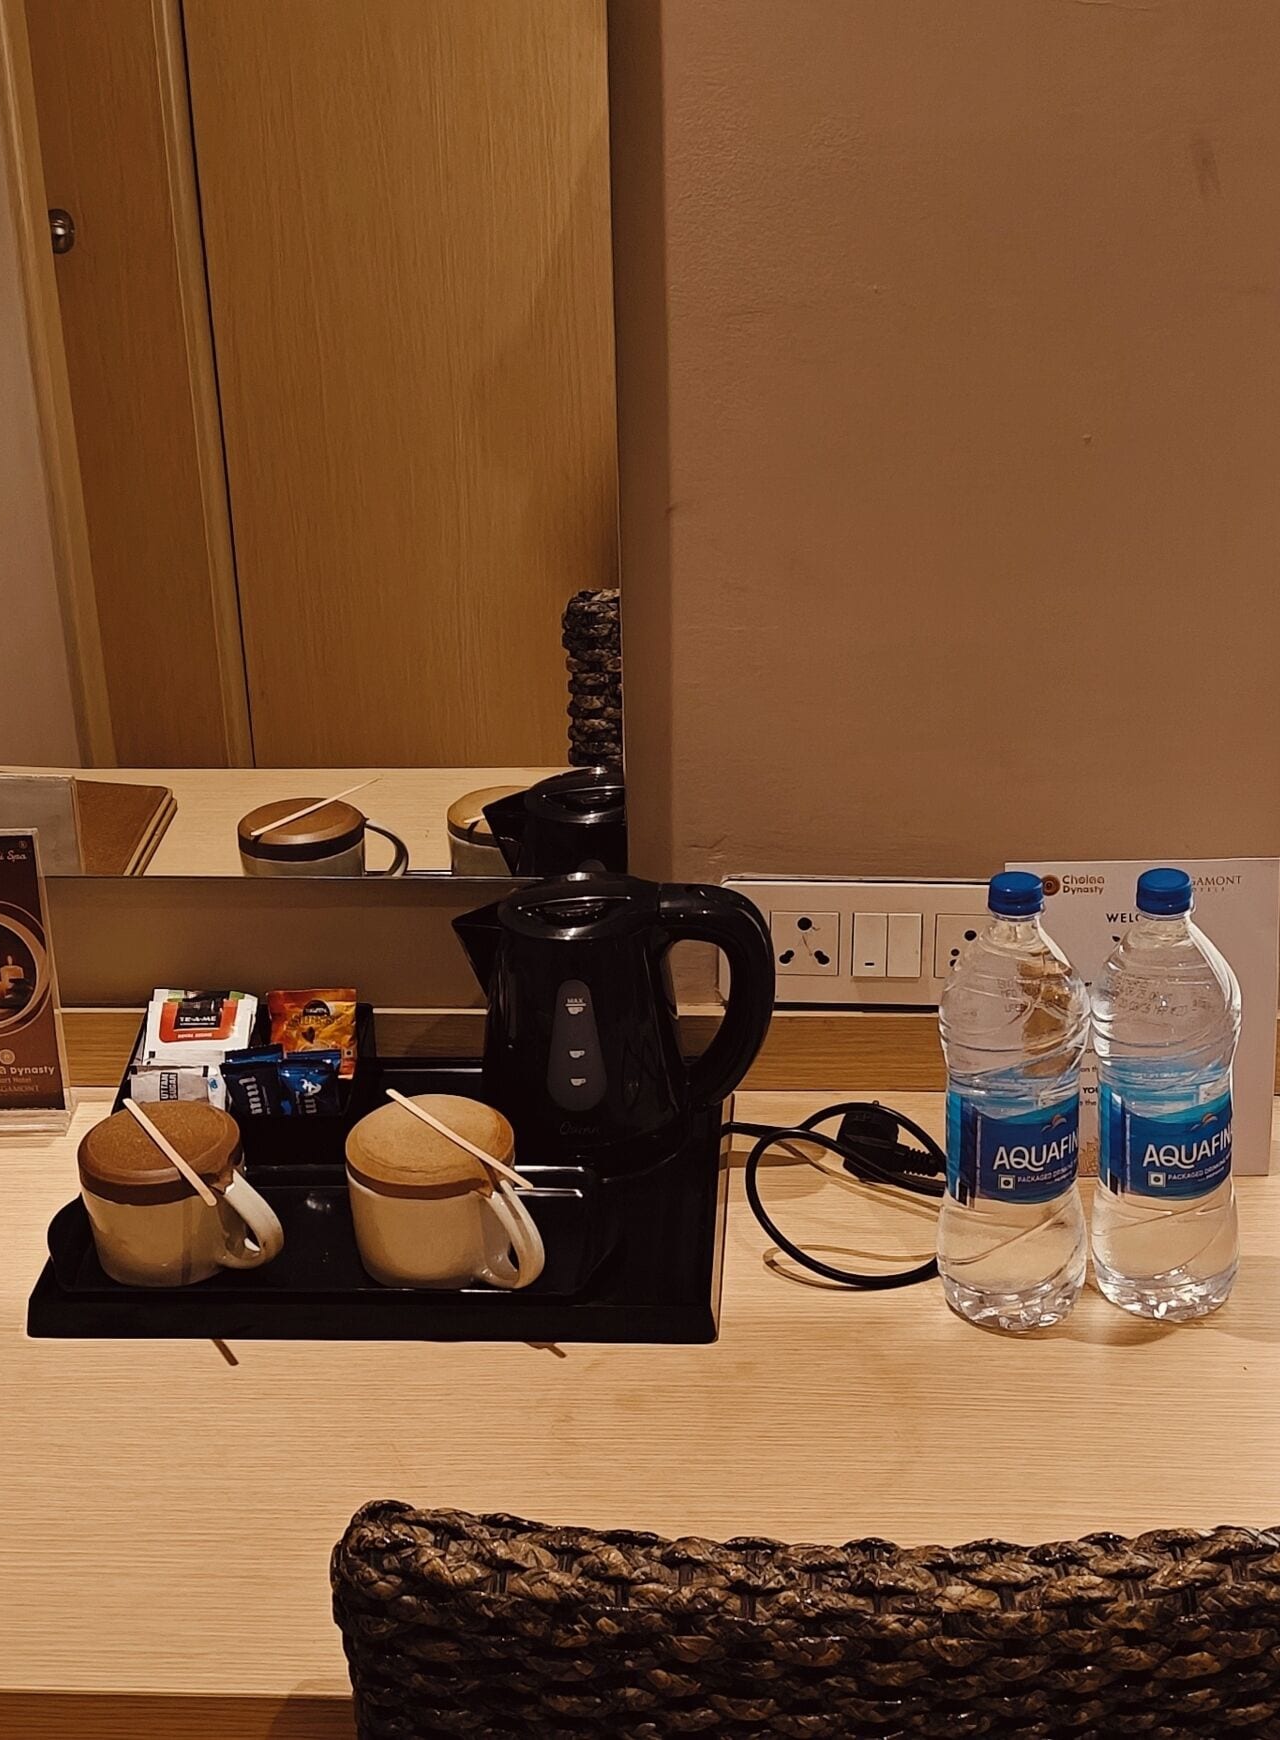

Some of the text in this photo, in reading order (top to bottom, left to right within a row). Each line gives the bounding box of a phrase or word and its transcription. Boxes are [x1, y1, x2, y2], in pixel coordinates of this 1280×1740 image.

[6, 849, 27, 863] Spa
[1192, 875, 1242, 886] AMONT
[1062, 885, 1104, 895] Dynasty
[993, 1130, 1079, 1172] AQUAFIN
[1142, 1122, 1232, 1169] AQUAFIN
[1167, 1169, 1204, 1181] PACKAGED
